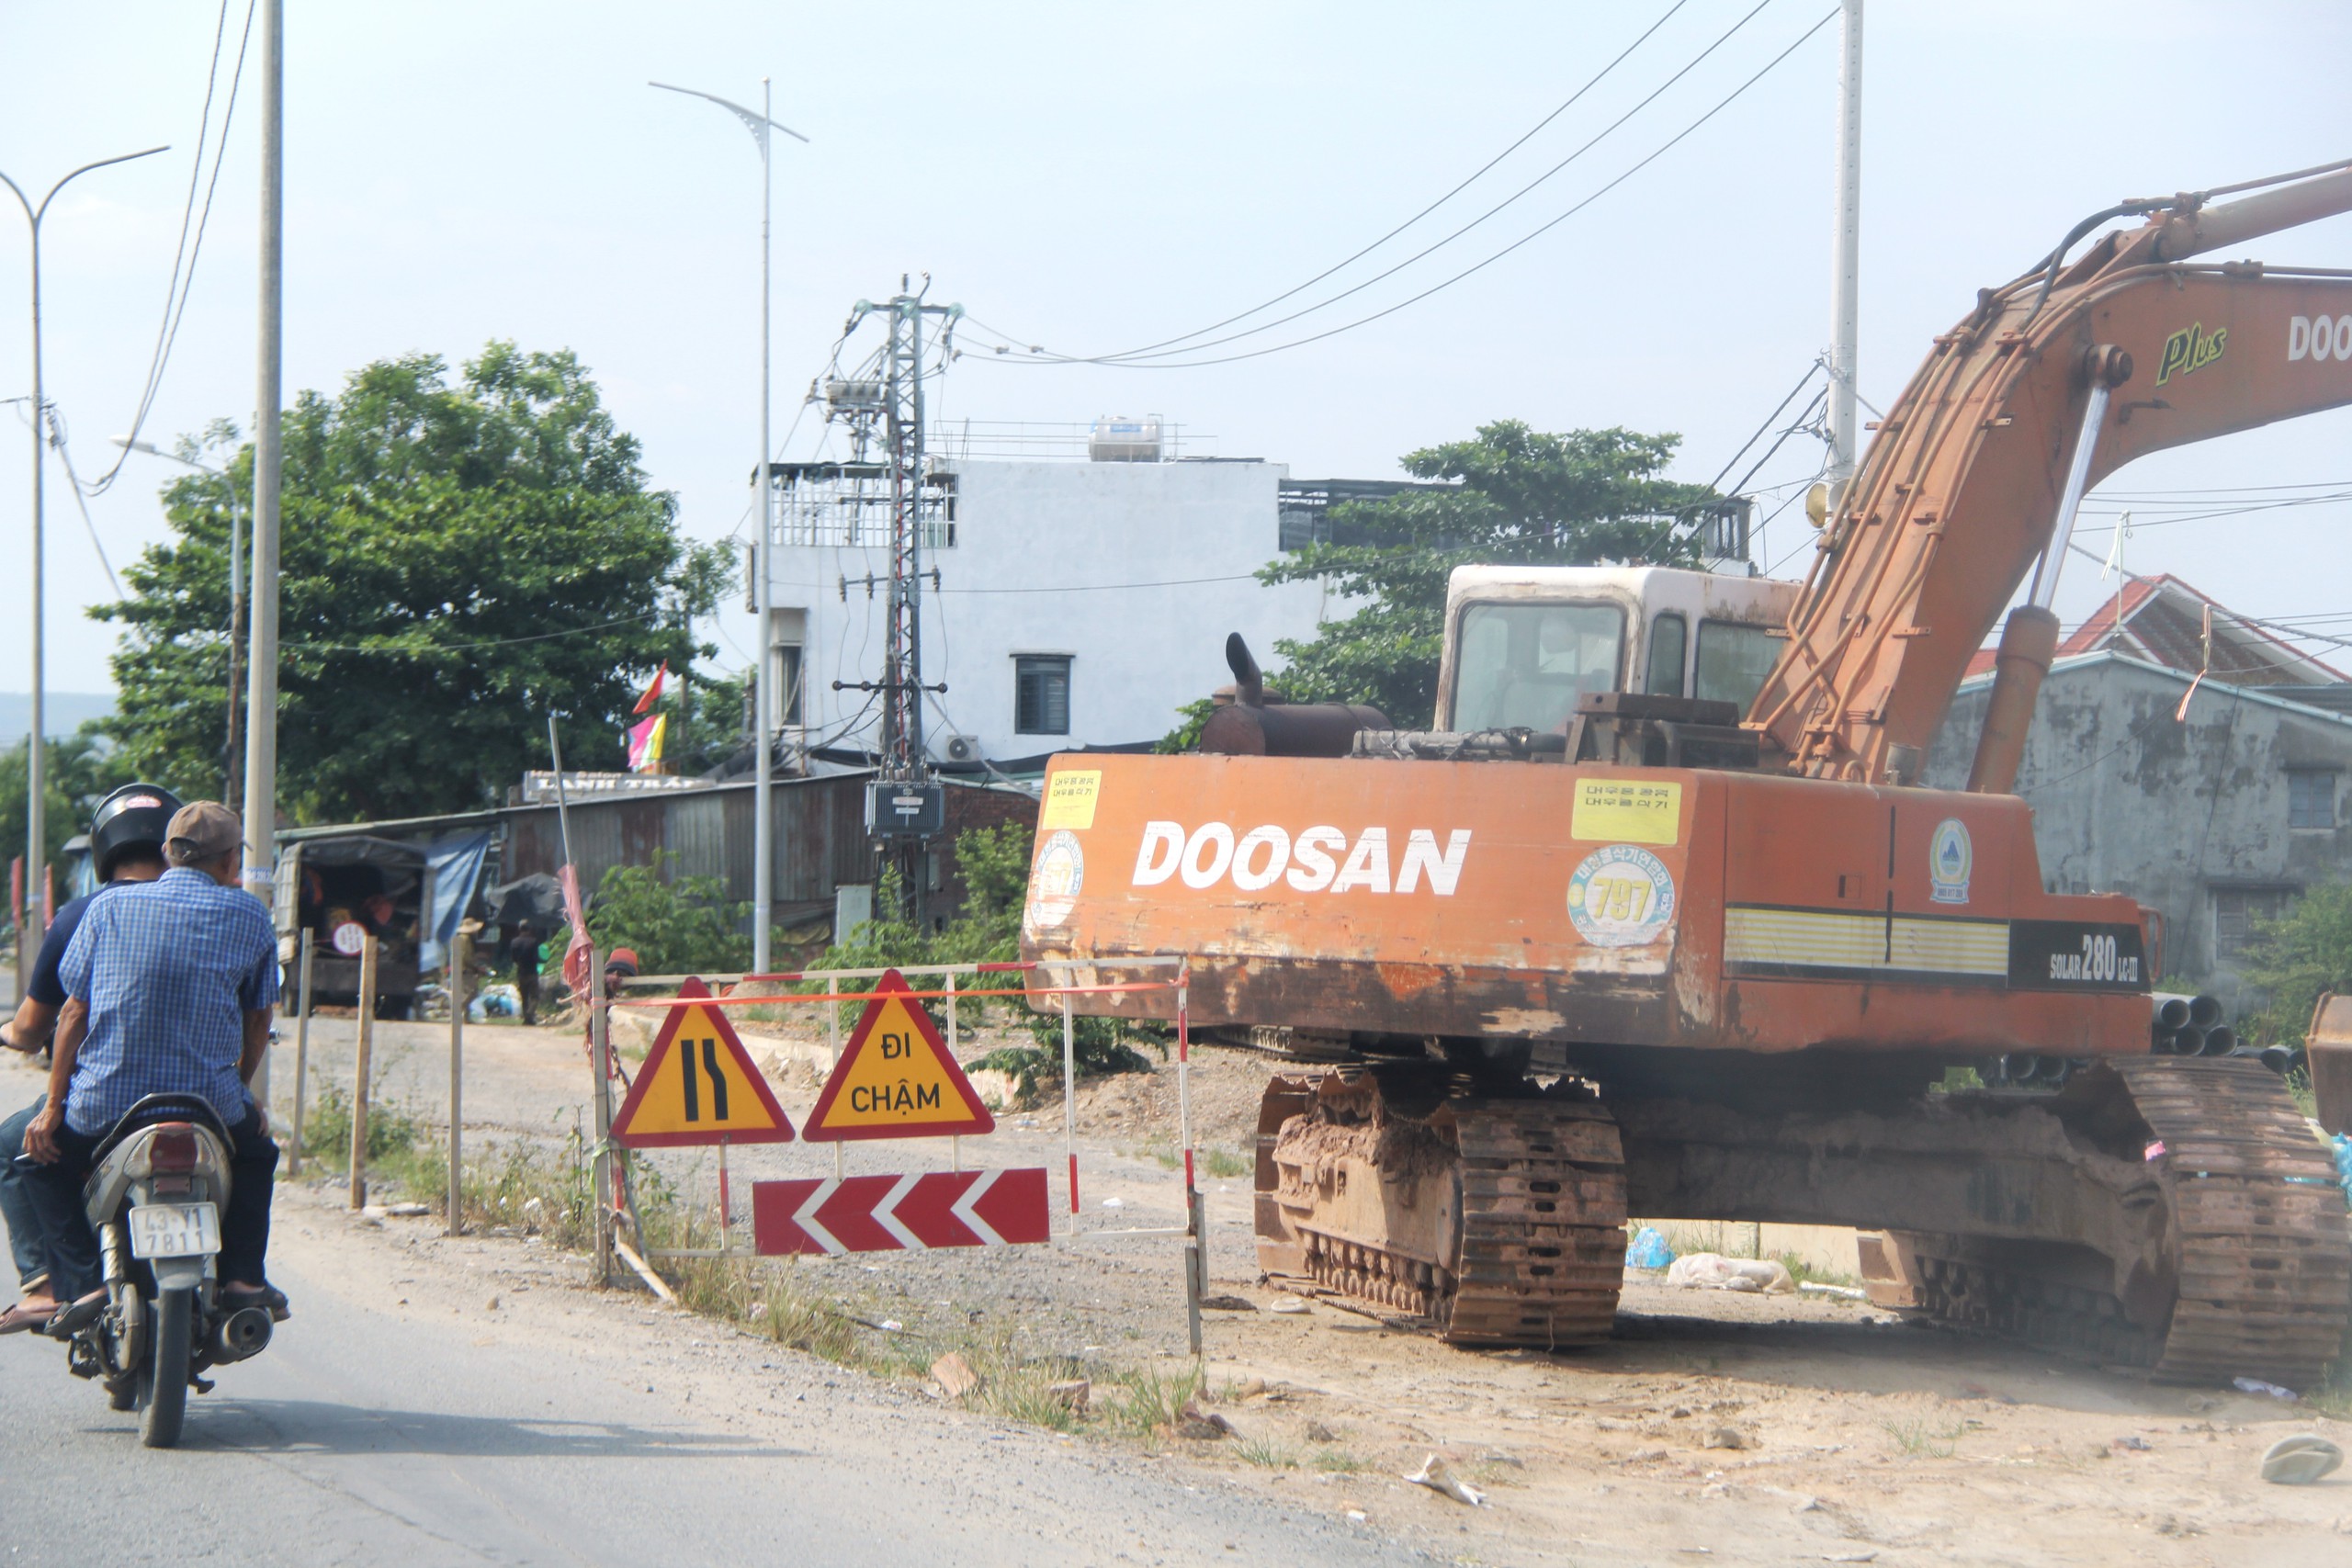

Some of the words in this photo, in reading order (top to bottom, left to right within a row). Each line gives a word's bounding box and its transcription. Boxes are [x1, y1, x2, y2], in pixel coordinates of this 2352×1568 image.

[2156, 321, 2227, 387] Plus
[1132, 820, 1472, 896] DOOSAN
[1594, 877, 1652, 922] 797
[2050, 953, 2081, 980] SOLAR
[2081, 934, 2116, 981] 280
[881, 1032, 910, 1060] ĐI
[851, 1078, 941, 1115] CHẬM
[146, 1230, 204, 1253] 7811
